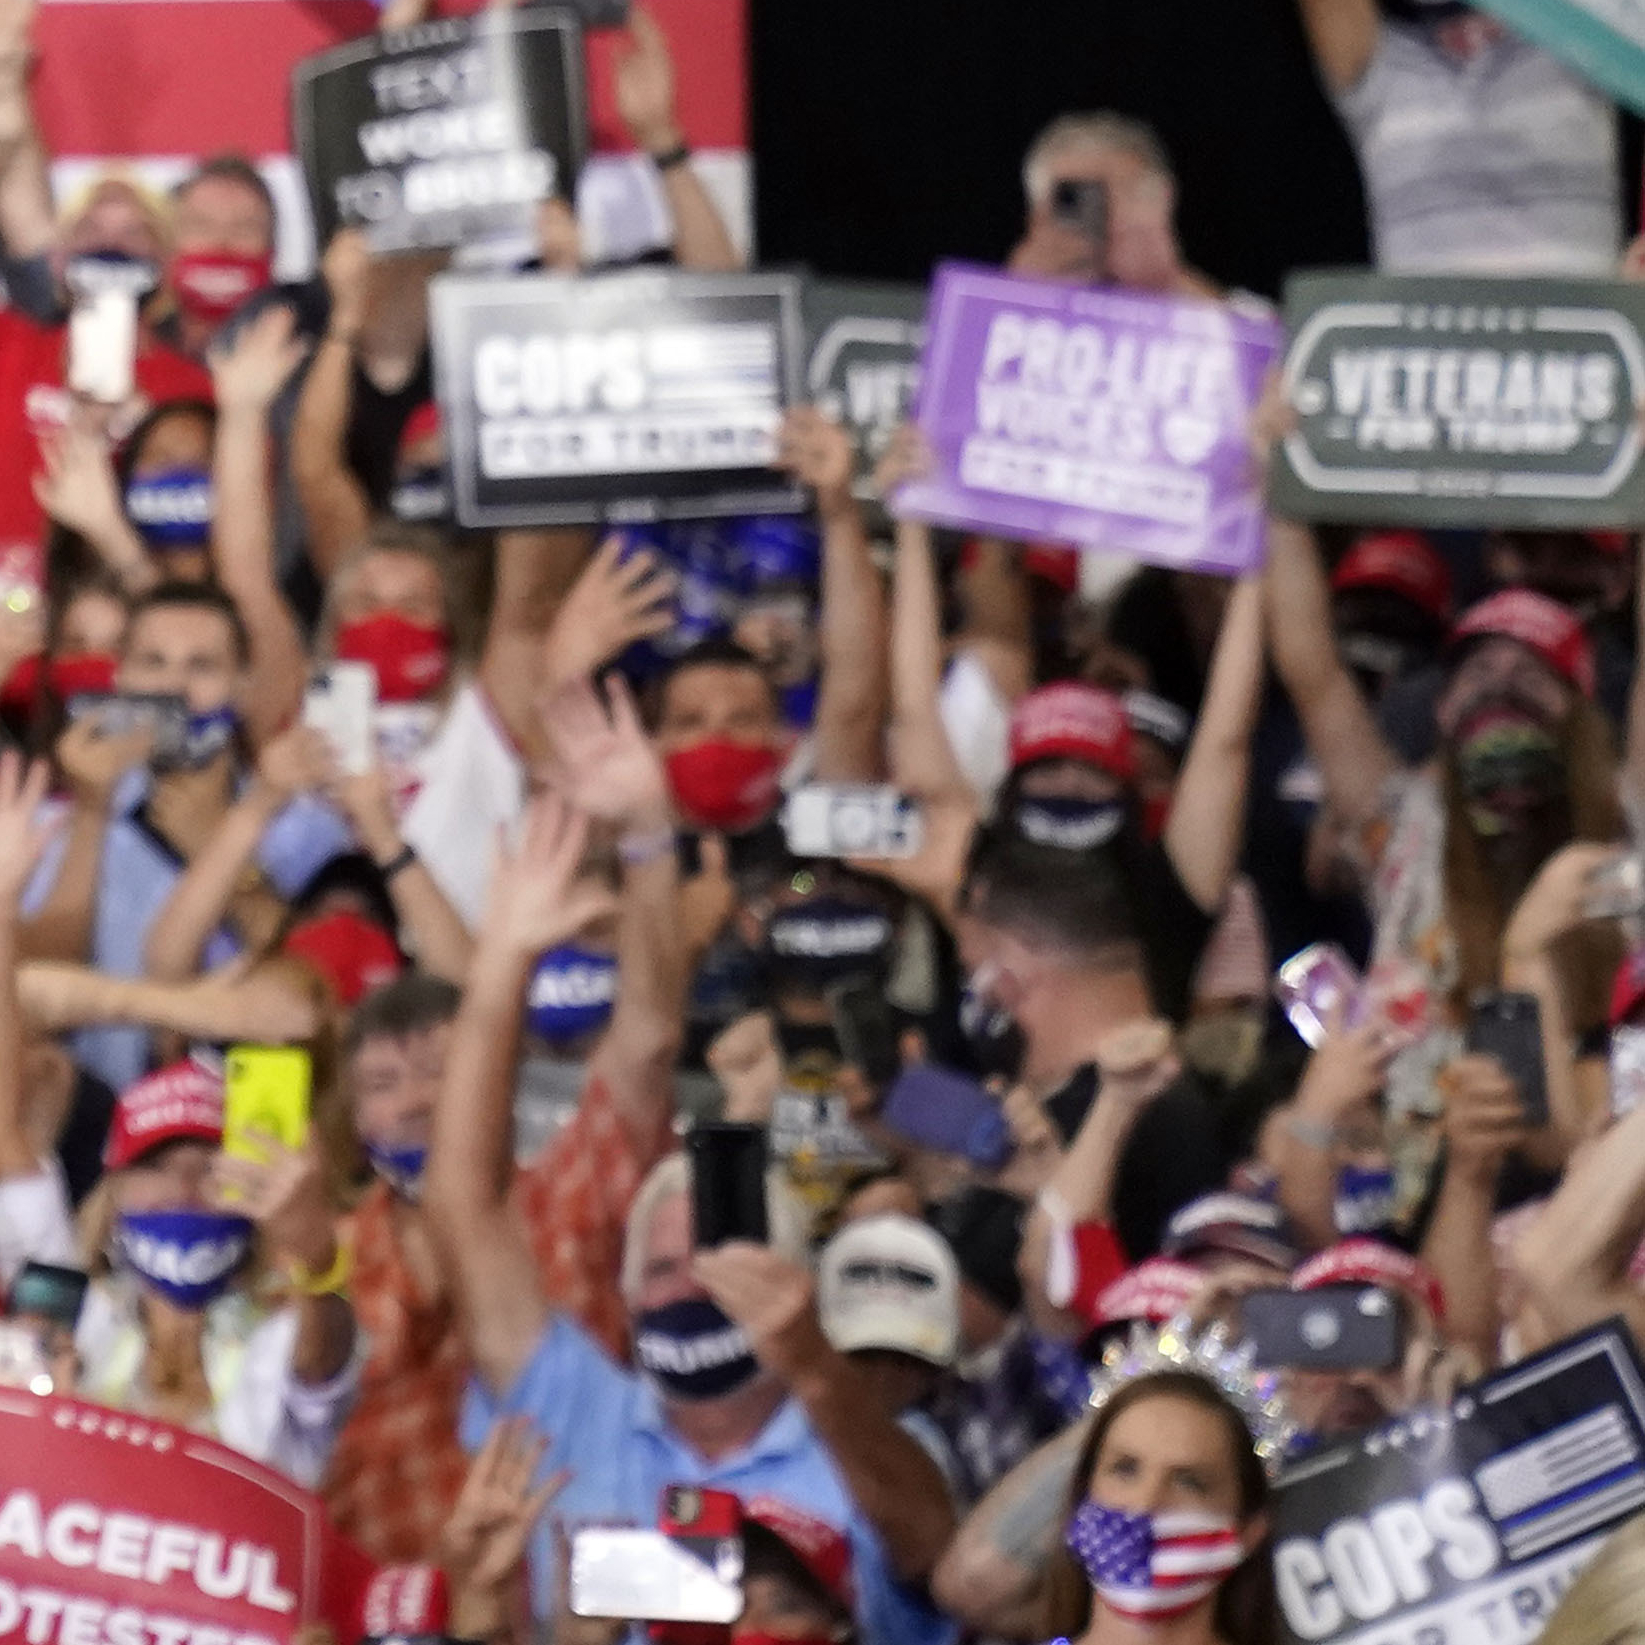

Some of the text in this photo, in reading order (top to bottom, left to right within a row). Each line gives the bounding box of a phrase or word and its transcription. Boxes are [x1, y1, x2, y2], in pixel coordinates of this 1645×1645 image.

[475, 330, 645, 417] COPS
[1330, 351, 1613, 422] VETERANS
[1273, 1474, 1502, 1642] COPS
